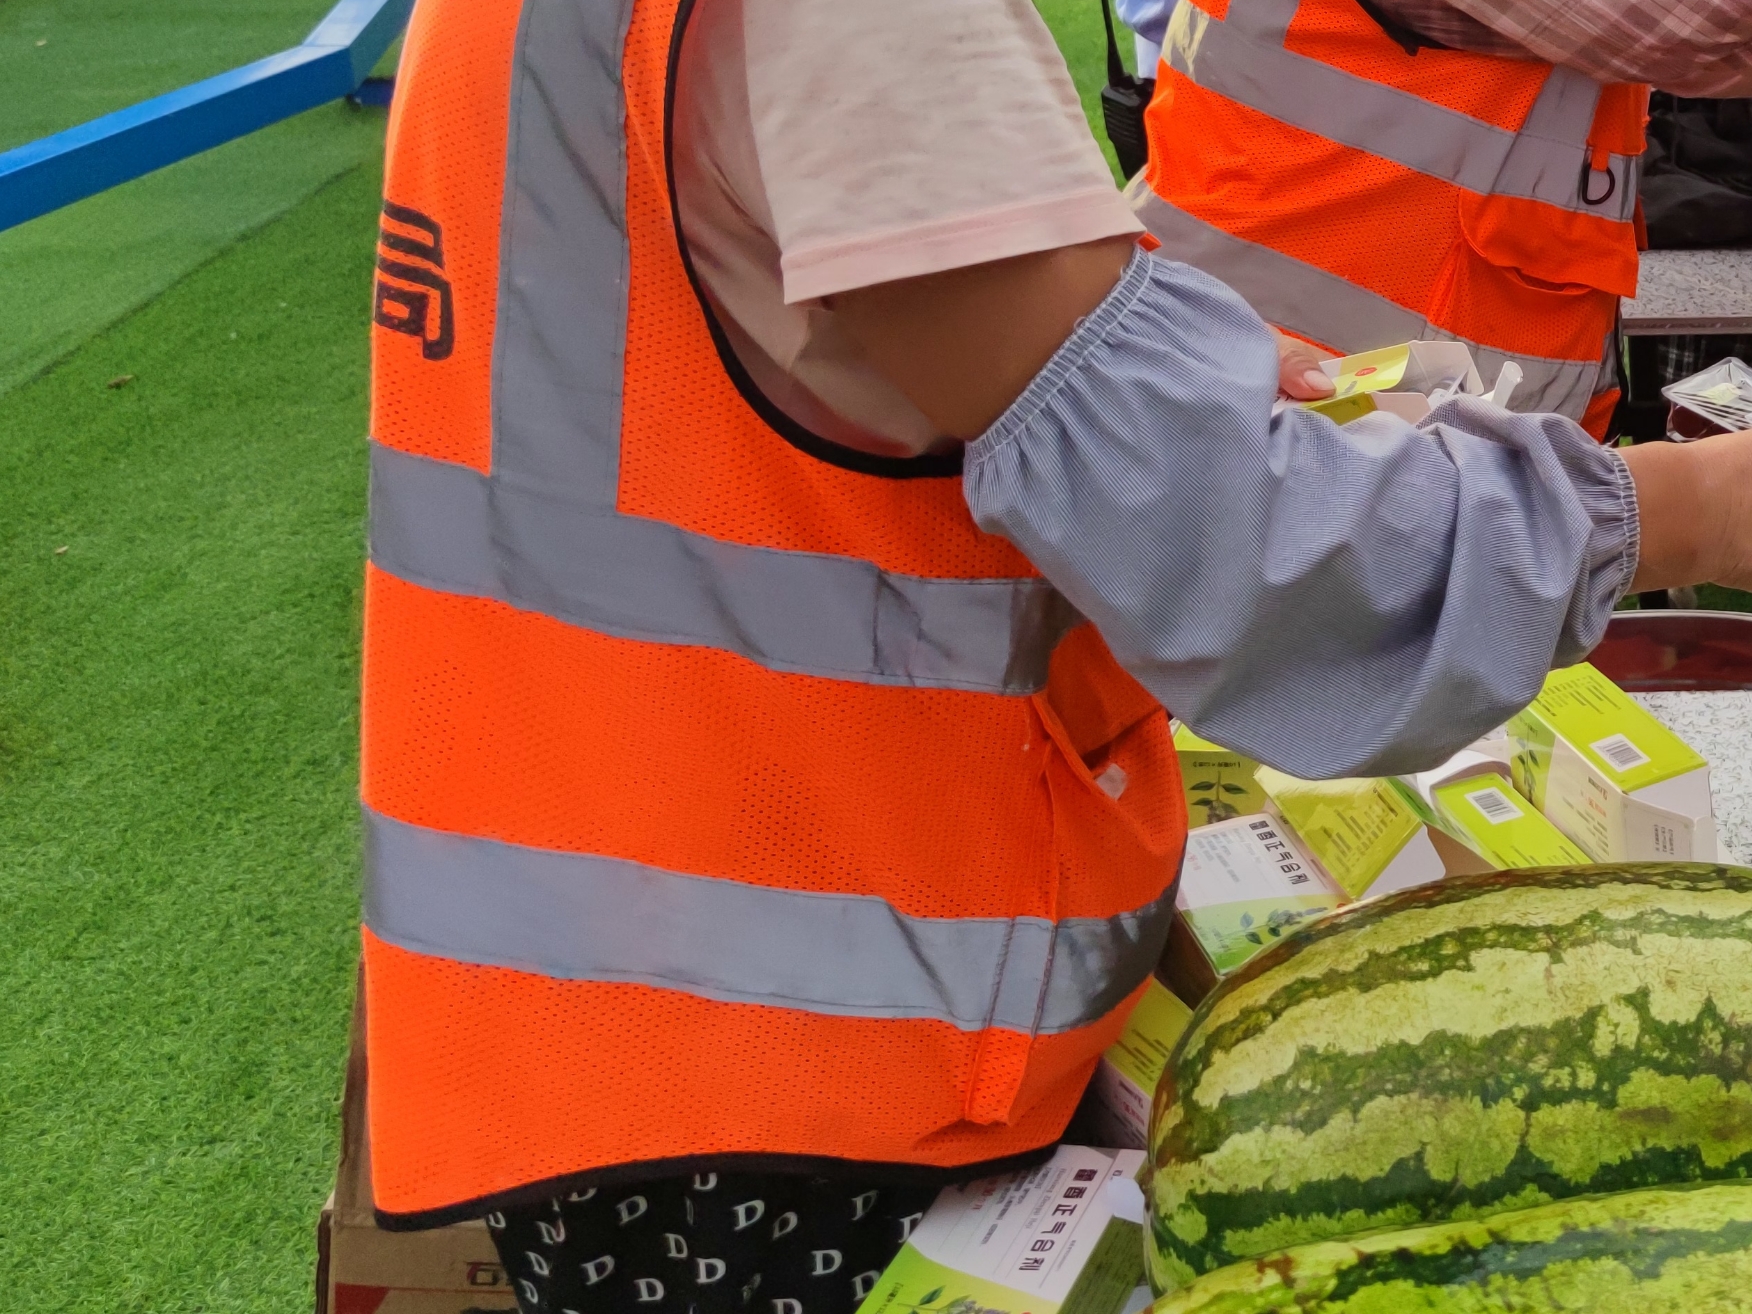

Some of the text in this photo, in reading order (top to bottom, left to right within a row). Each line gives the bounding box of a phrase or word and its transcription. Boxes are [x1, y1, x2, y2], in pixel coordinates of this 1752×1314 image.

[697, 1258, 726, 1284] D
[811, 1249, 842, 1276] D
[637, 1278, 665, 1302] D
